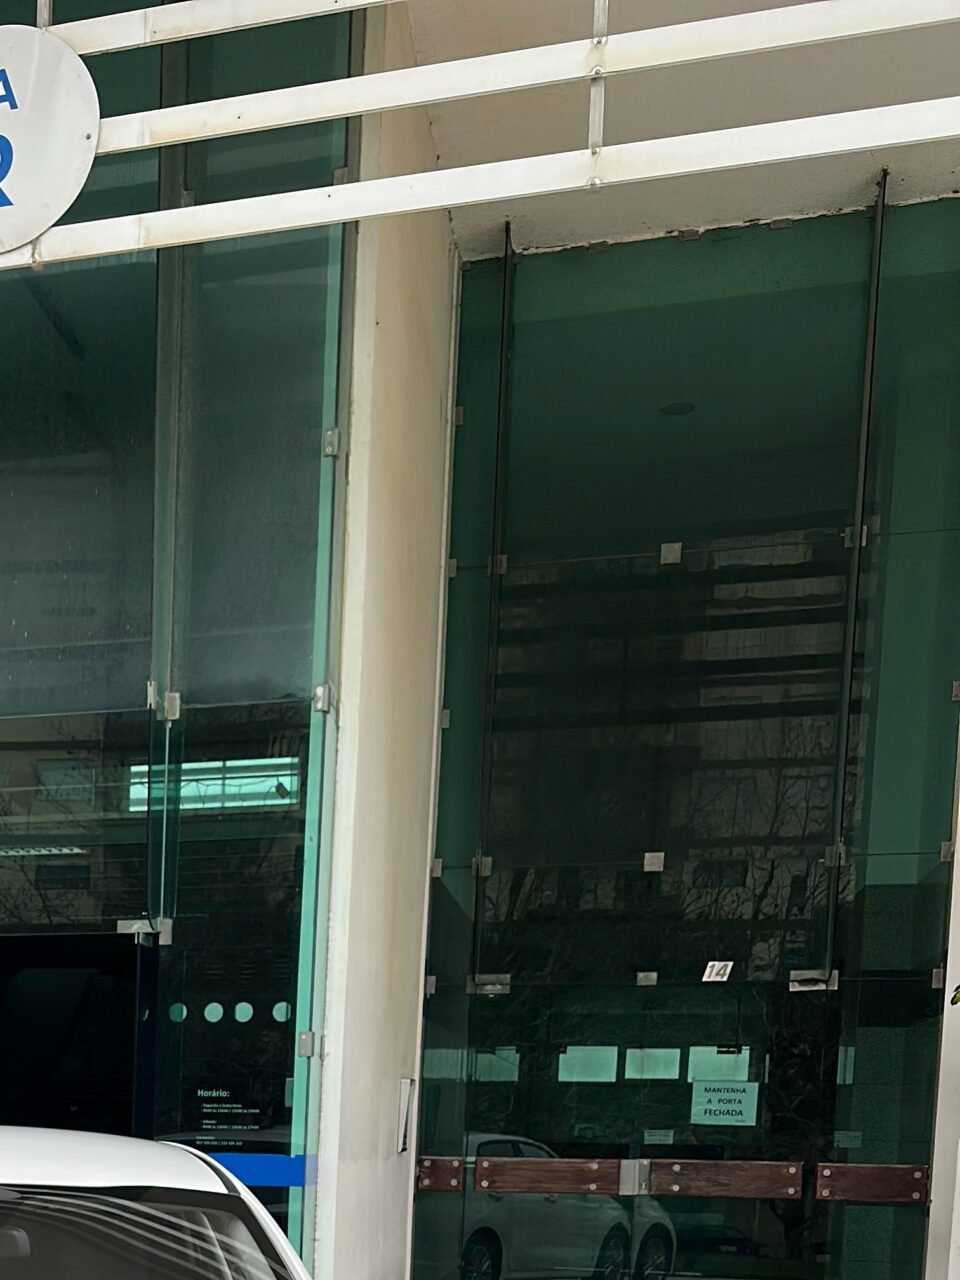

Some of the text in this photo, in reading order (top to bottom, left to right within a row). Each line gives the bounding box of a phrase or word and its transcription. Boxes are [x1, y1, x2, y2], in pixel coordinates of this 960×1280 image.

[707, 964, 728, 979] 14
[197, 1089, 230, 1097] Horário:
[704, 1109, 744, 1117] FECHADA
